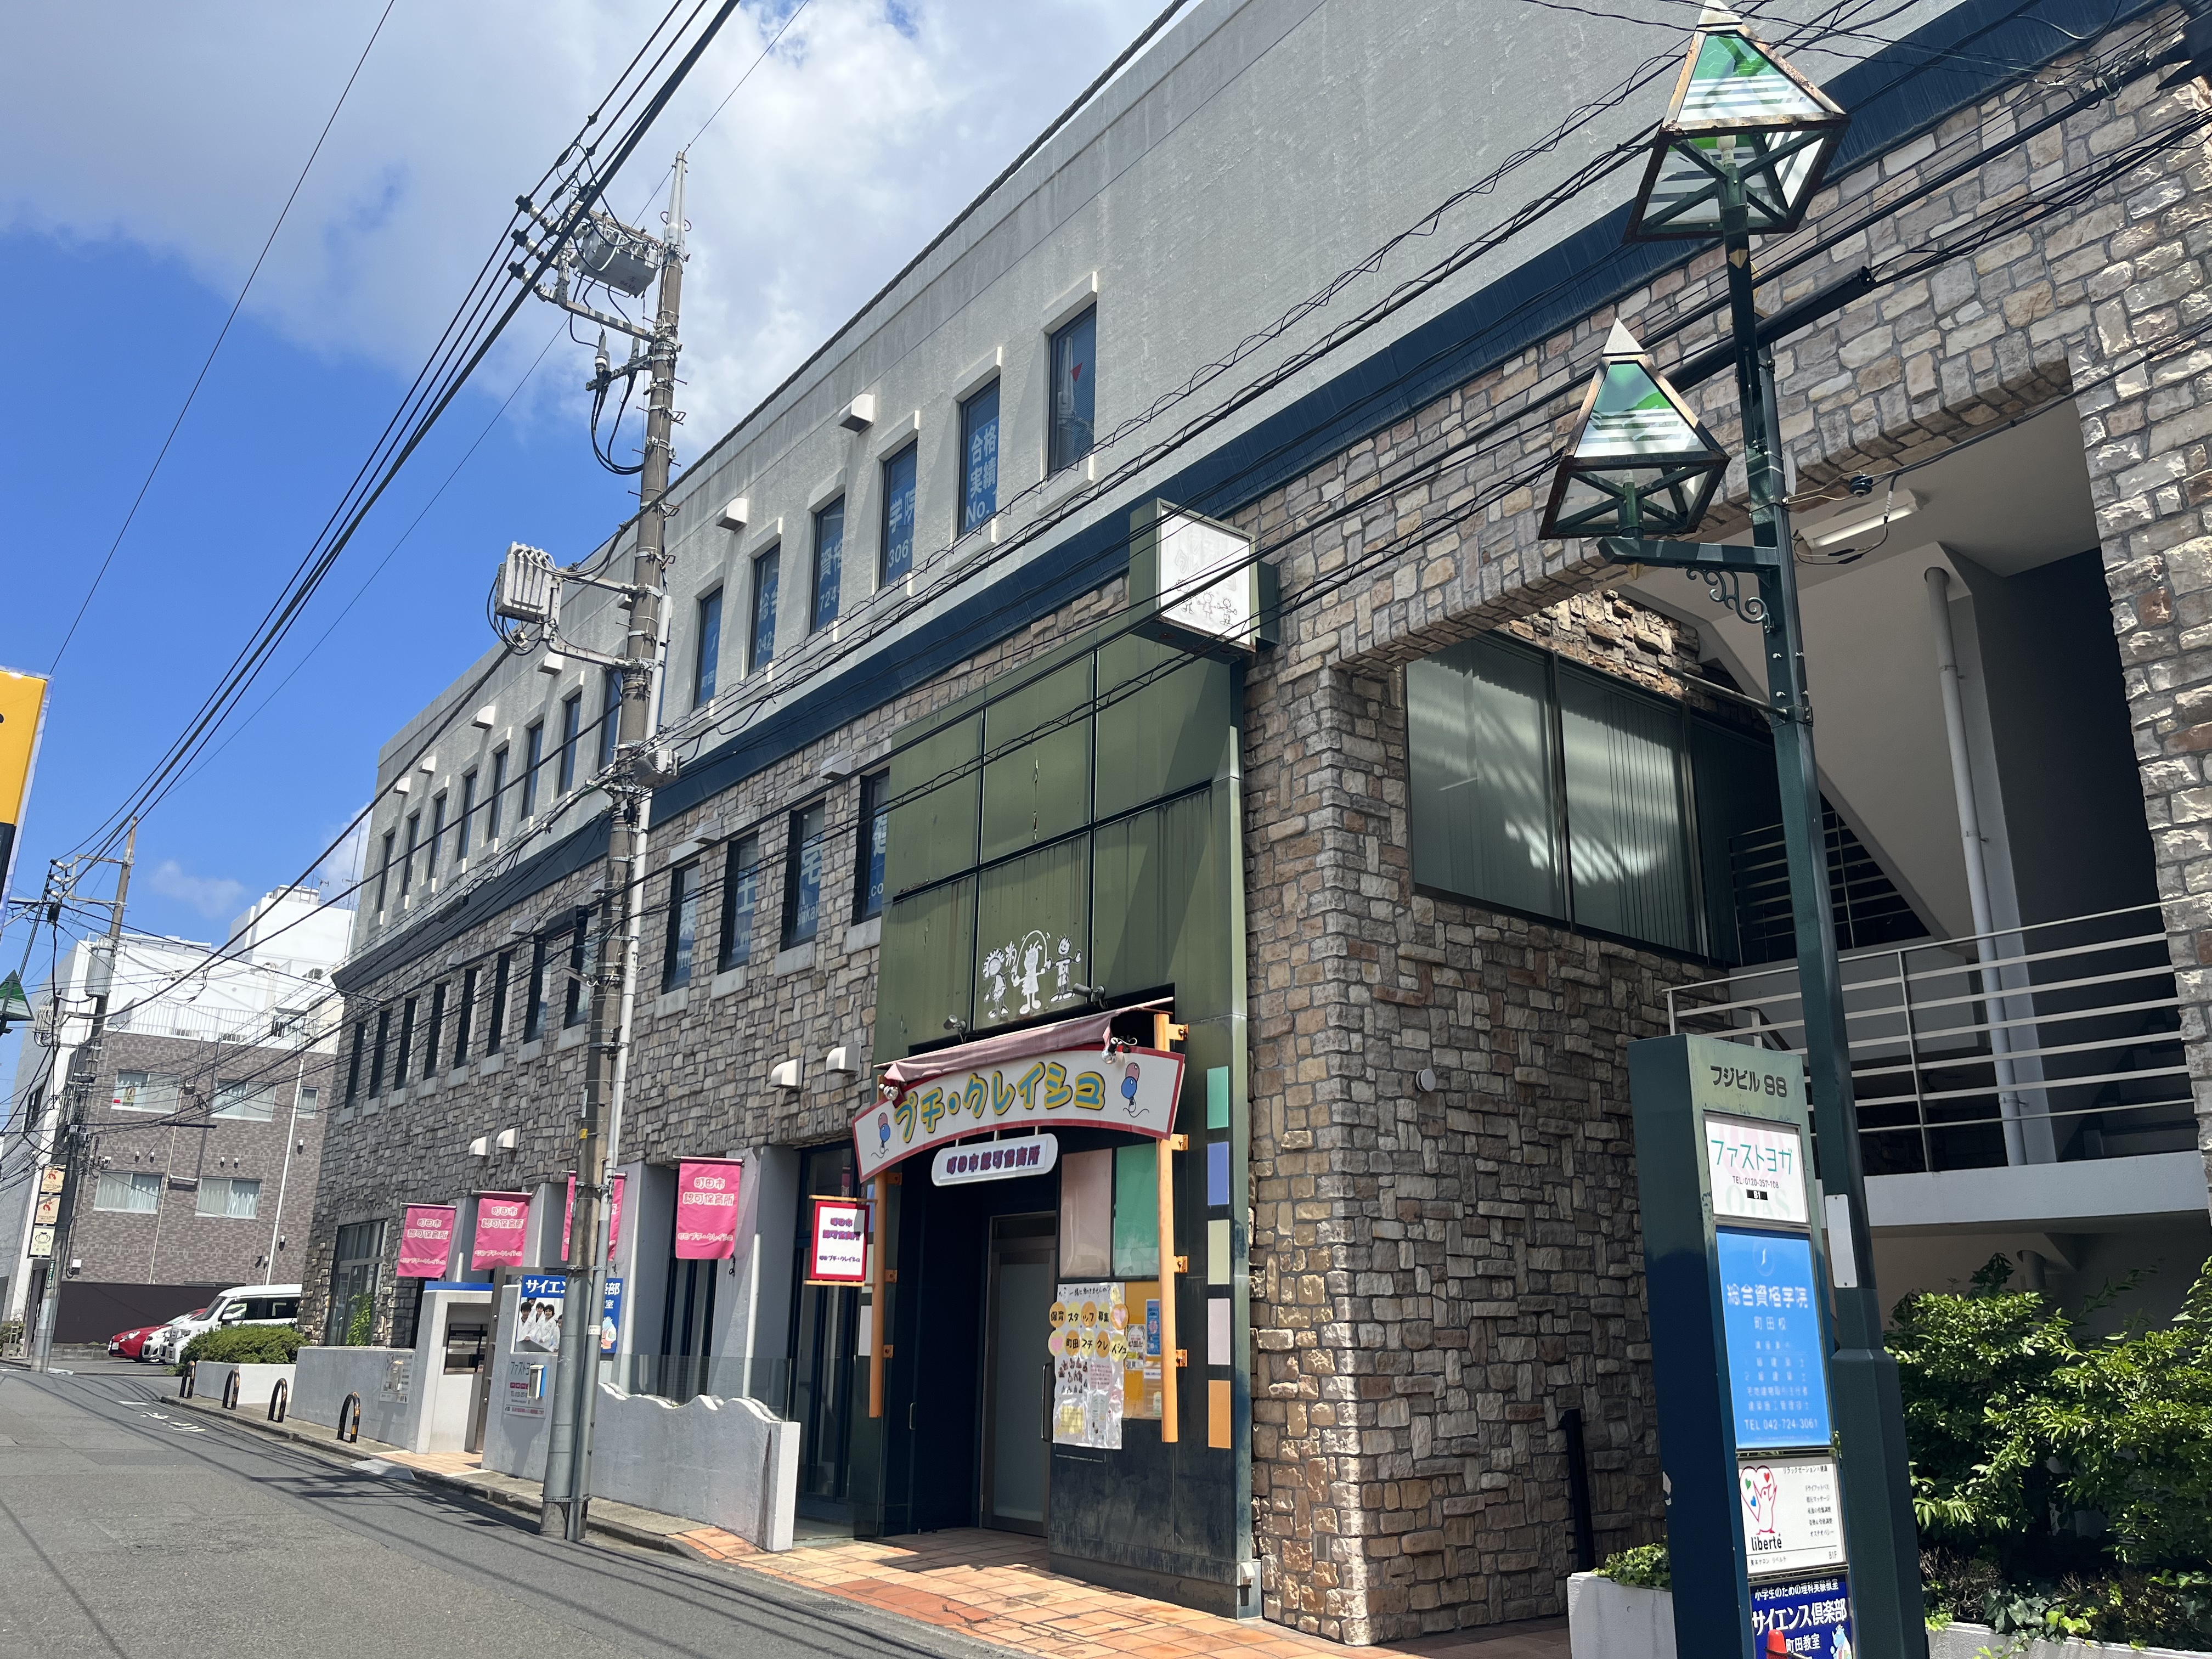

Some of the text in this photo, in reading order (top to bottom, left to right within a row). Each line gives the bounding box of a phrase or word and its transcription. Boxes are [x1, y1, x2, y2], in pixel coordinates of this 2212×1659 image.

[972, 424, 997, 466] 合格
[970, 456, 996, 499] 実績
[894, 1062, 1105, 1143] プチ・クレイシュ
[1711, 1139, 1792, 1175] ファストヨガ
[694, 1177, 725, 1189] 町田市
[682, 1192, 734, 1206] 認可保育所
[492, 1206, 518, 1216] 町田市
[417, 1218, 442, 1228] 町田市
[481, 1218, 523, 1228] 認可保育所
[408, 1229, 448, 1239] 認可保育所
[1726, 1283, 1809, 1308] 総合資格学院
[1744, 1419, 1760, 1431] TEL
[1751, 1533, 1781, 1551] liberté
[1754, 1578, 1839, 1601] 小学生のための理科実験教室
[1752, 1598, 1847, 1636] サイエンス倶楽部
[1786, 1633, 1820, 1653] 町田教室
